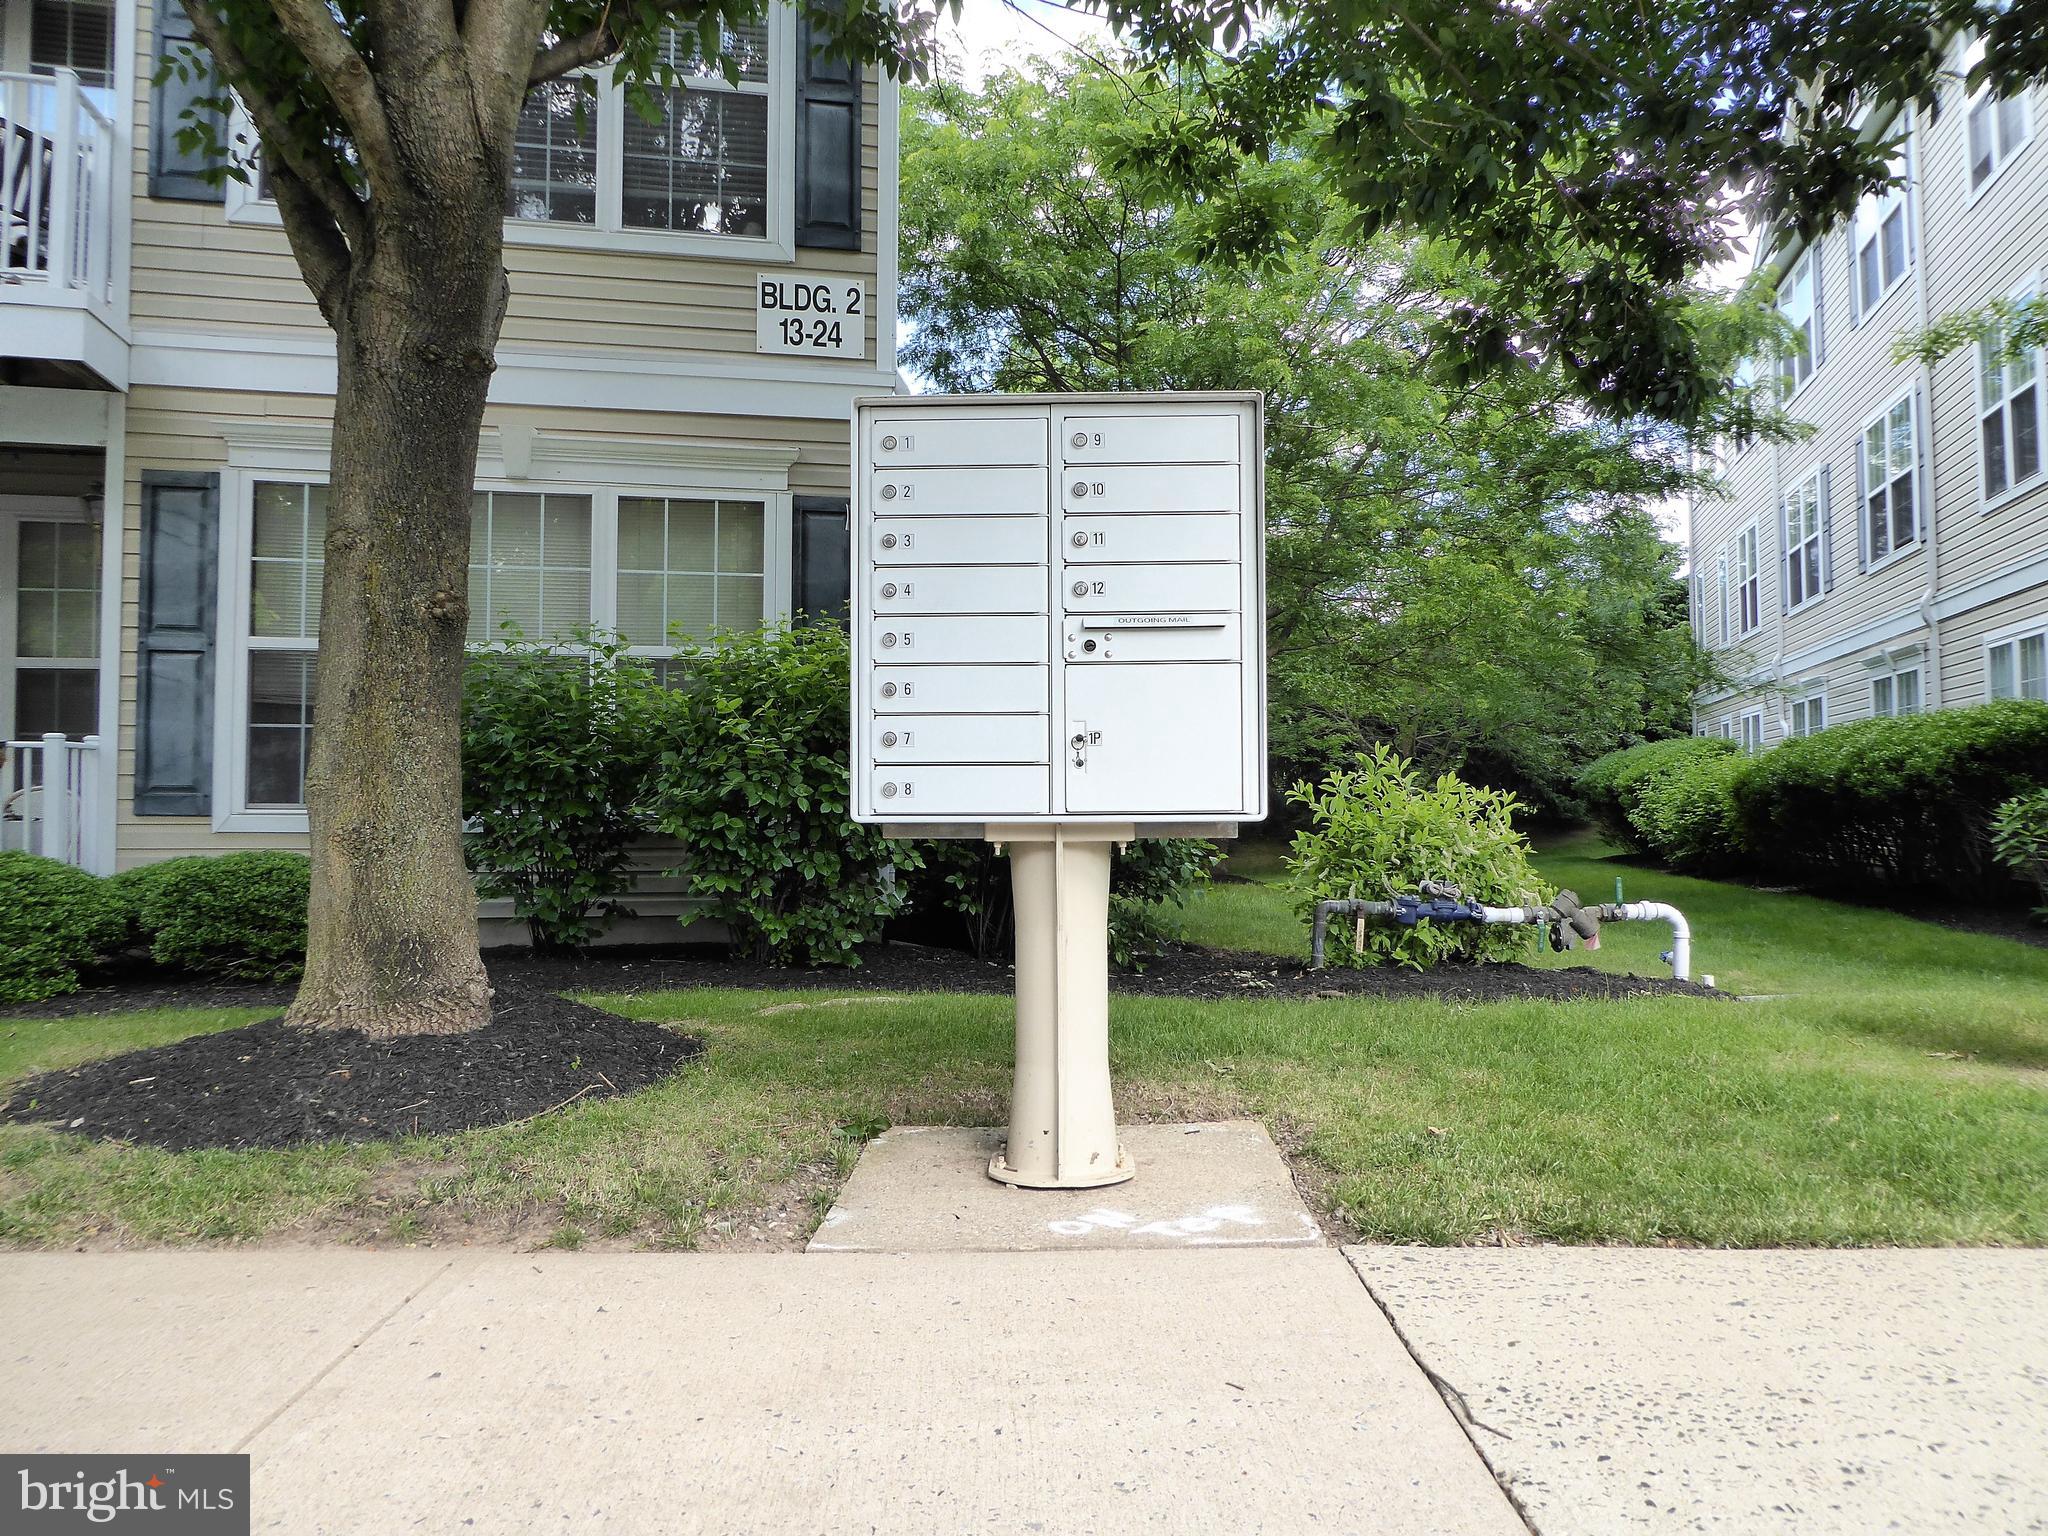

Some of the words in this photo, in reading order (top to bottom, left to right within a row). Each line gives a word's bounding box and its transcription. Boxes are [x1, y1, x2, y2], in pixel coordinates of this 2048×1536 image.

[761, 282, 837, 313] BLDG.
[846, 287, 861, 315] 2
[779, 318, 843, 348] 13-24
[1093, 433, 1102, 446] 9
[903, 485, 911, 498] 2
[1091, 483, 1104, 496] 10
[903, 534, 912, 547] 3
[1092, 532, 1104, 545] 11
[903, 584, 912, 596] 4
[1091, 582, 1104, 595] 12
[903, 633, 911, 646] 5
[904, 682, 912, 696] 6
[903, 732, 911, 745] 7
[1088, 731, 1101, 745] 1P
[904, 783, 912, 796] 8
